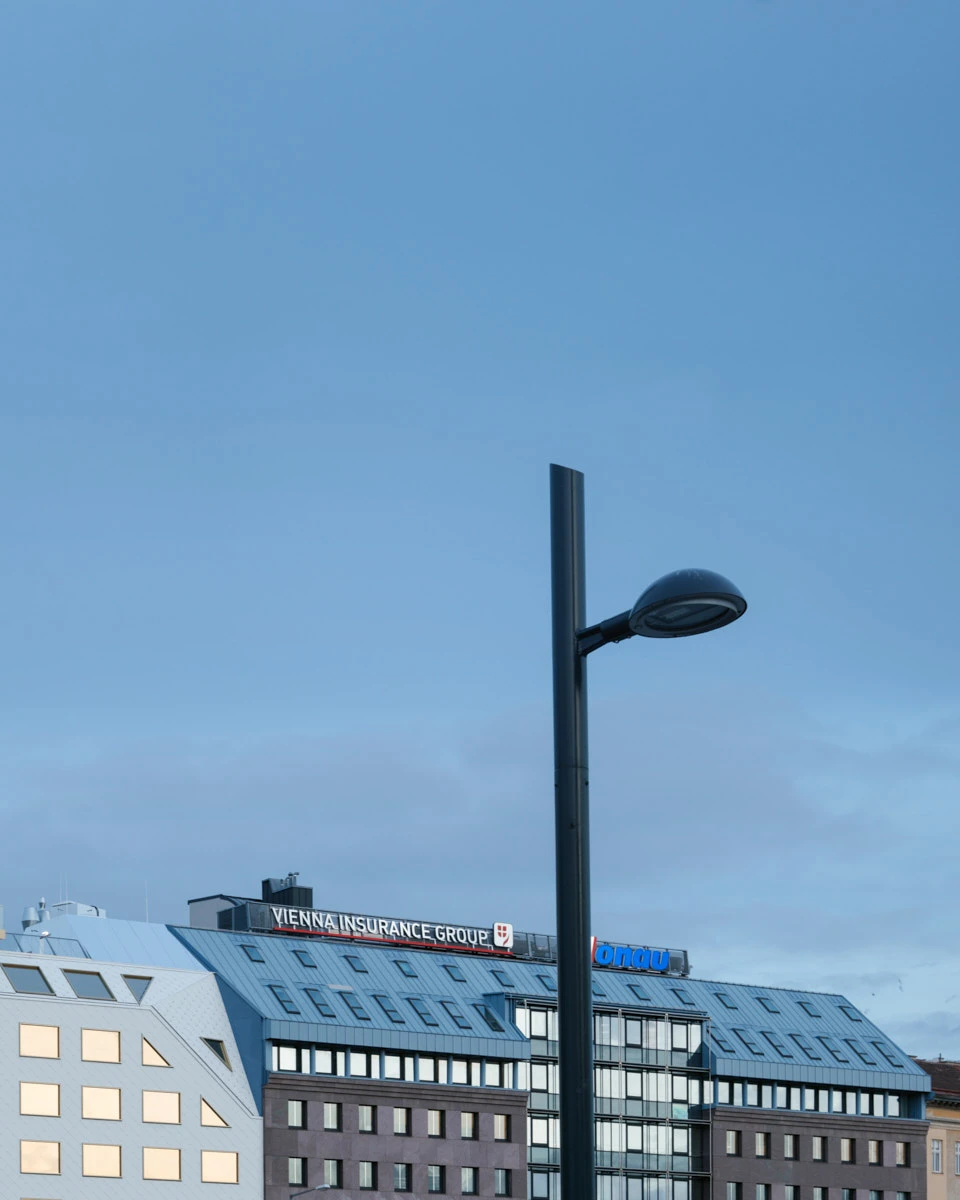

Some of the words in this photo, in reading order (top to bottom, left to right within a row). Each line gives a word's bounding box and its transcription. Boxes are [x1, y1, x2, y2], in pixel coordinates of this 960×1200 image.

[271, 907, 335, 929] VIENNA
[339, 915, 431, 940] INSURANCE
[435, 925, 488, 945] GROUP
[591, 936, 670, 970] onau
